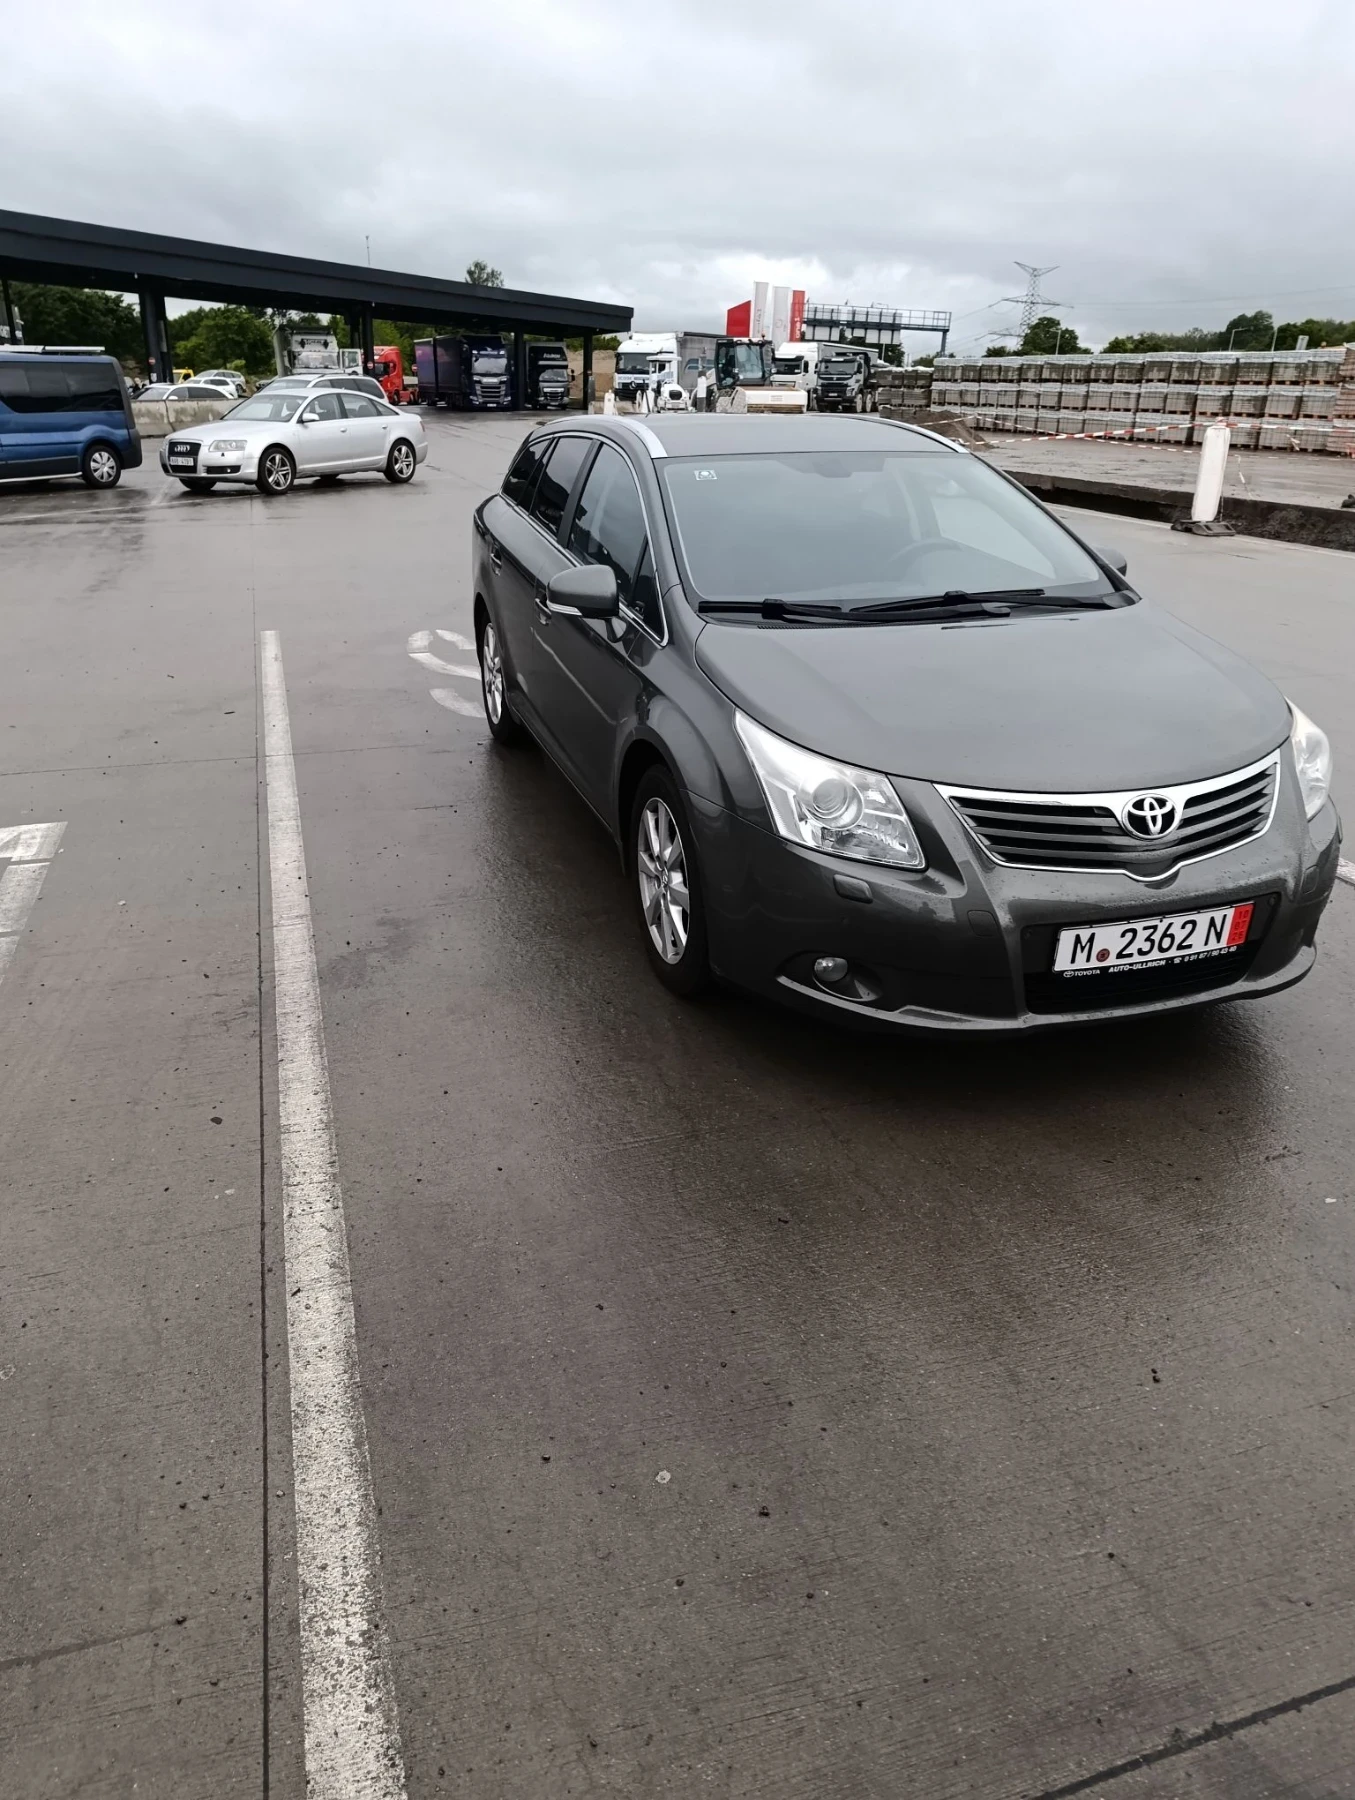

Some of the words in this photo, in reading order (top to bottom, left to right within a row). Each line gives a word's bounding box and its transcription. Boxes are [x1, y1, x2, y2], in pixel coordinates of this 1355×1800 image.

[1070, 932, 1095, 964] M
[1116, 919, 1197, 960] 2362
[1204, 914, 1227, 946] N
[1074, 969, 1100, 977] TOYOTA
[1108, 959, 1166, 973] AUTO-ULLRICH
